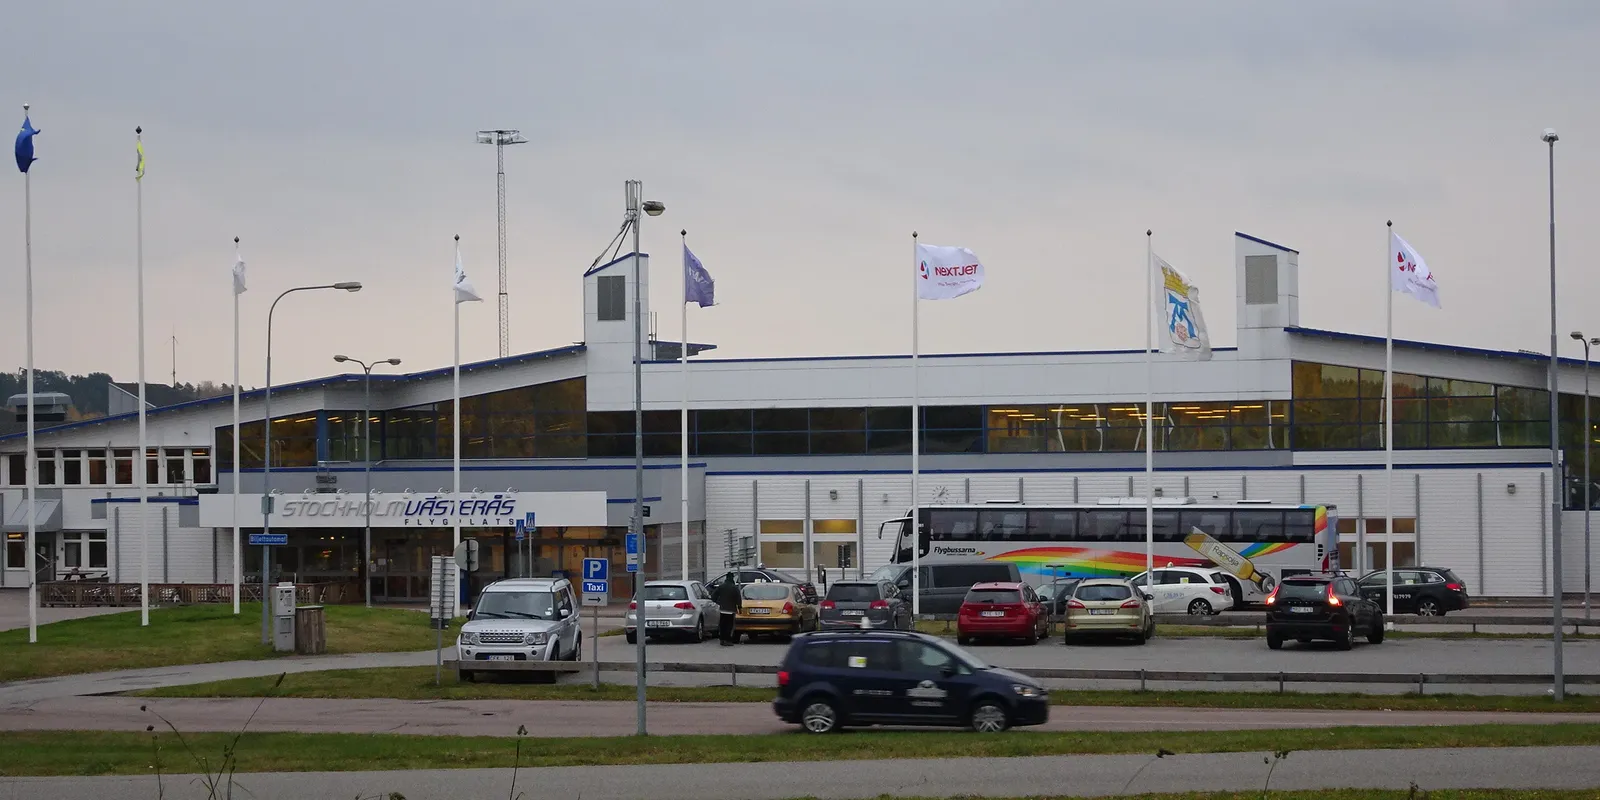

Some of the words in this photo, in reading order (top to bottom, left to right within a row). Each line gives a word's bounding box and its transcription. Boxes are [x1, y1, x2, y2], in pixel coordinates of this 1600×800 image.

[404, 518, 515, 526] FLYGLATS
[933, 546, 976, 554] Flygbussarna
[1212, 545, 1240, 566] Rapsolja
[590, 561, 601, 578] P
[587, 583, 604, 591] Taxi
